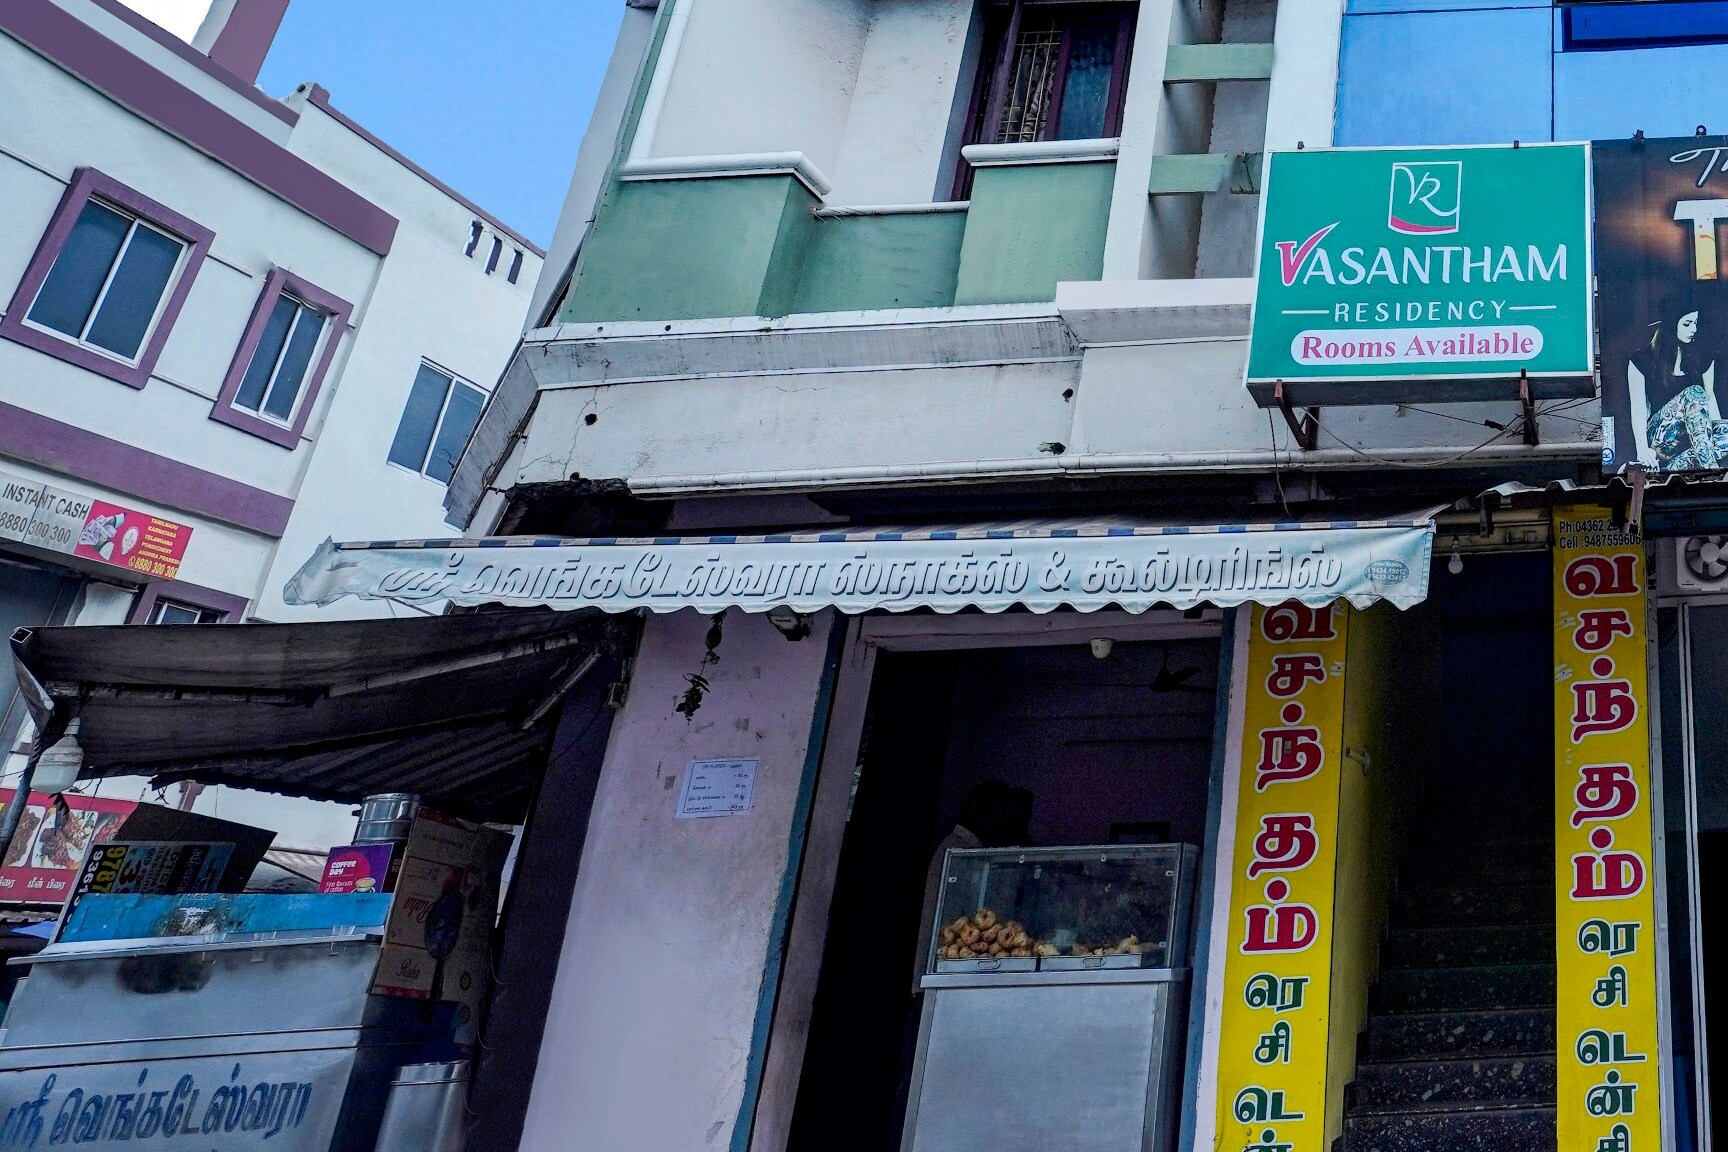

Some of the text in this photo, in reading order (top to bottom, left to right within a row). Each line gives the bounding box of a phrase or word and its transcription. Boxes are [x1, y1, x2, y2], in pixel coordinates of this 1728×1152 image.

[1274, 221, 1567, 287] VASANTHAM
[1335, 300, 1506, 323] RESIDENCY
[1301, 332, 1534, 360] Rooms Available
[2, 483, 90, 520] INSTANT CASH
[28, 520, 49, 539] 300
[50, 525, 71, 544] 300
[1560, 536, 1578, 549] Cell
[1038, 550, 1072, 593] &
